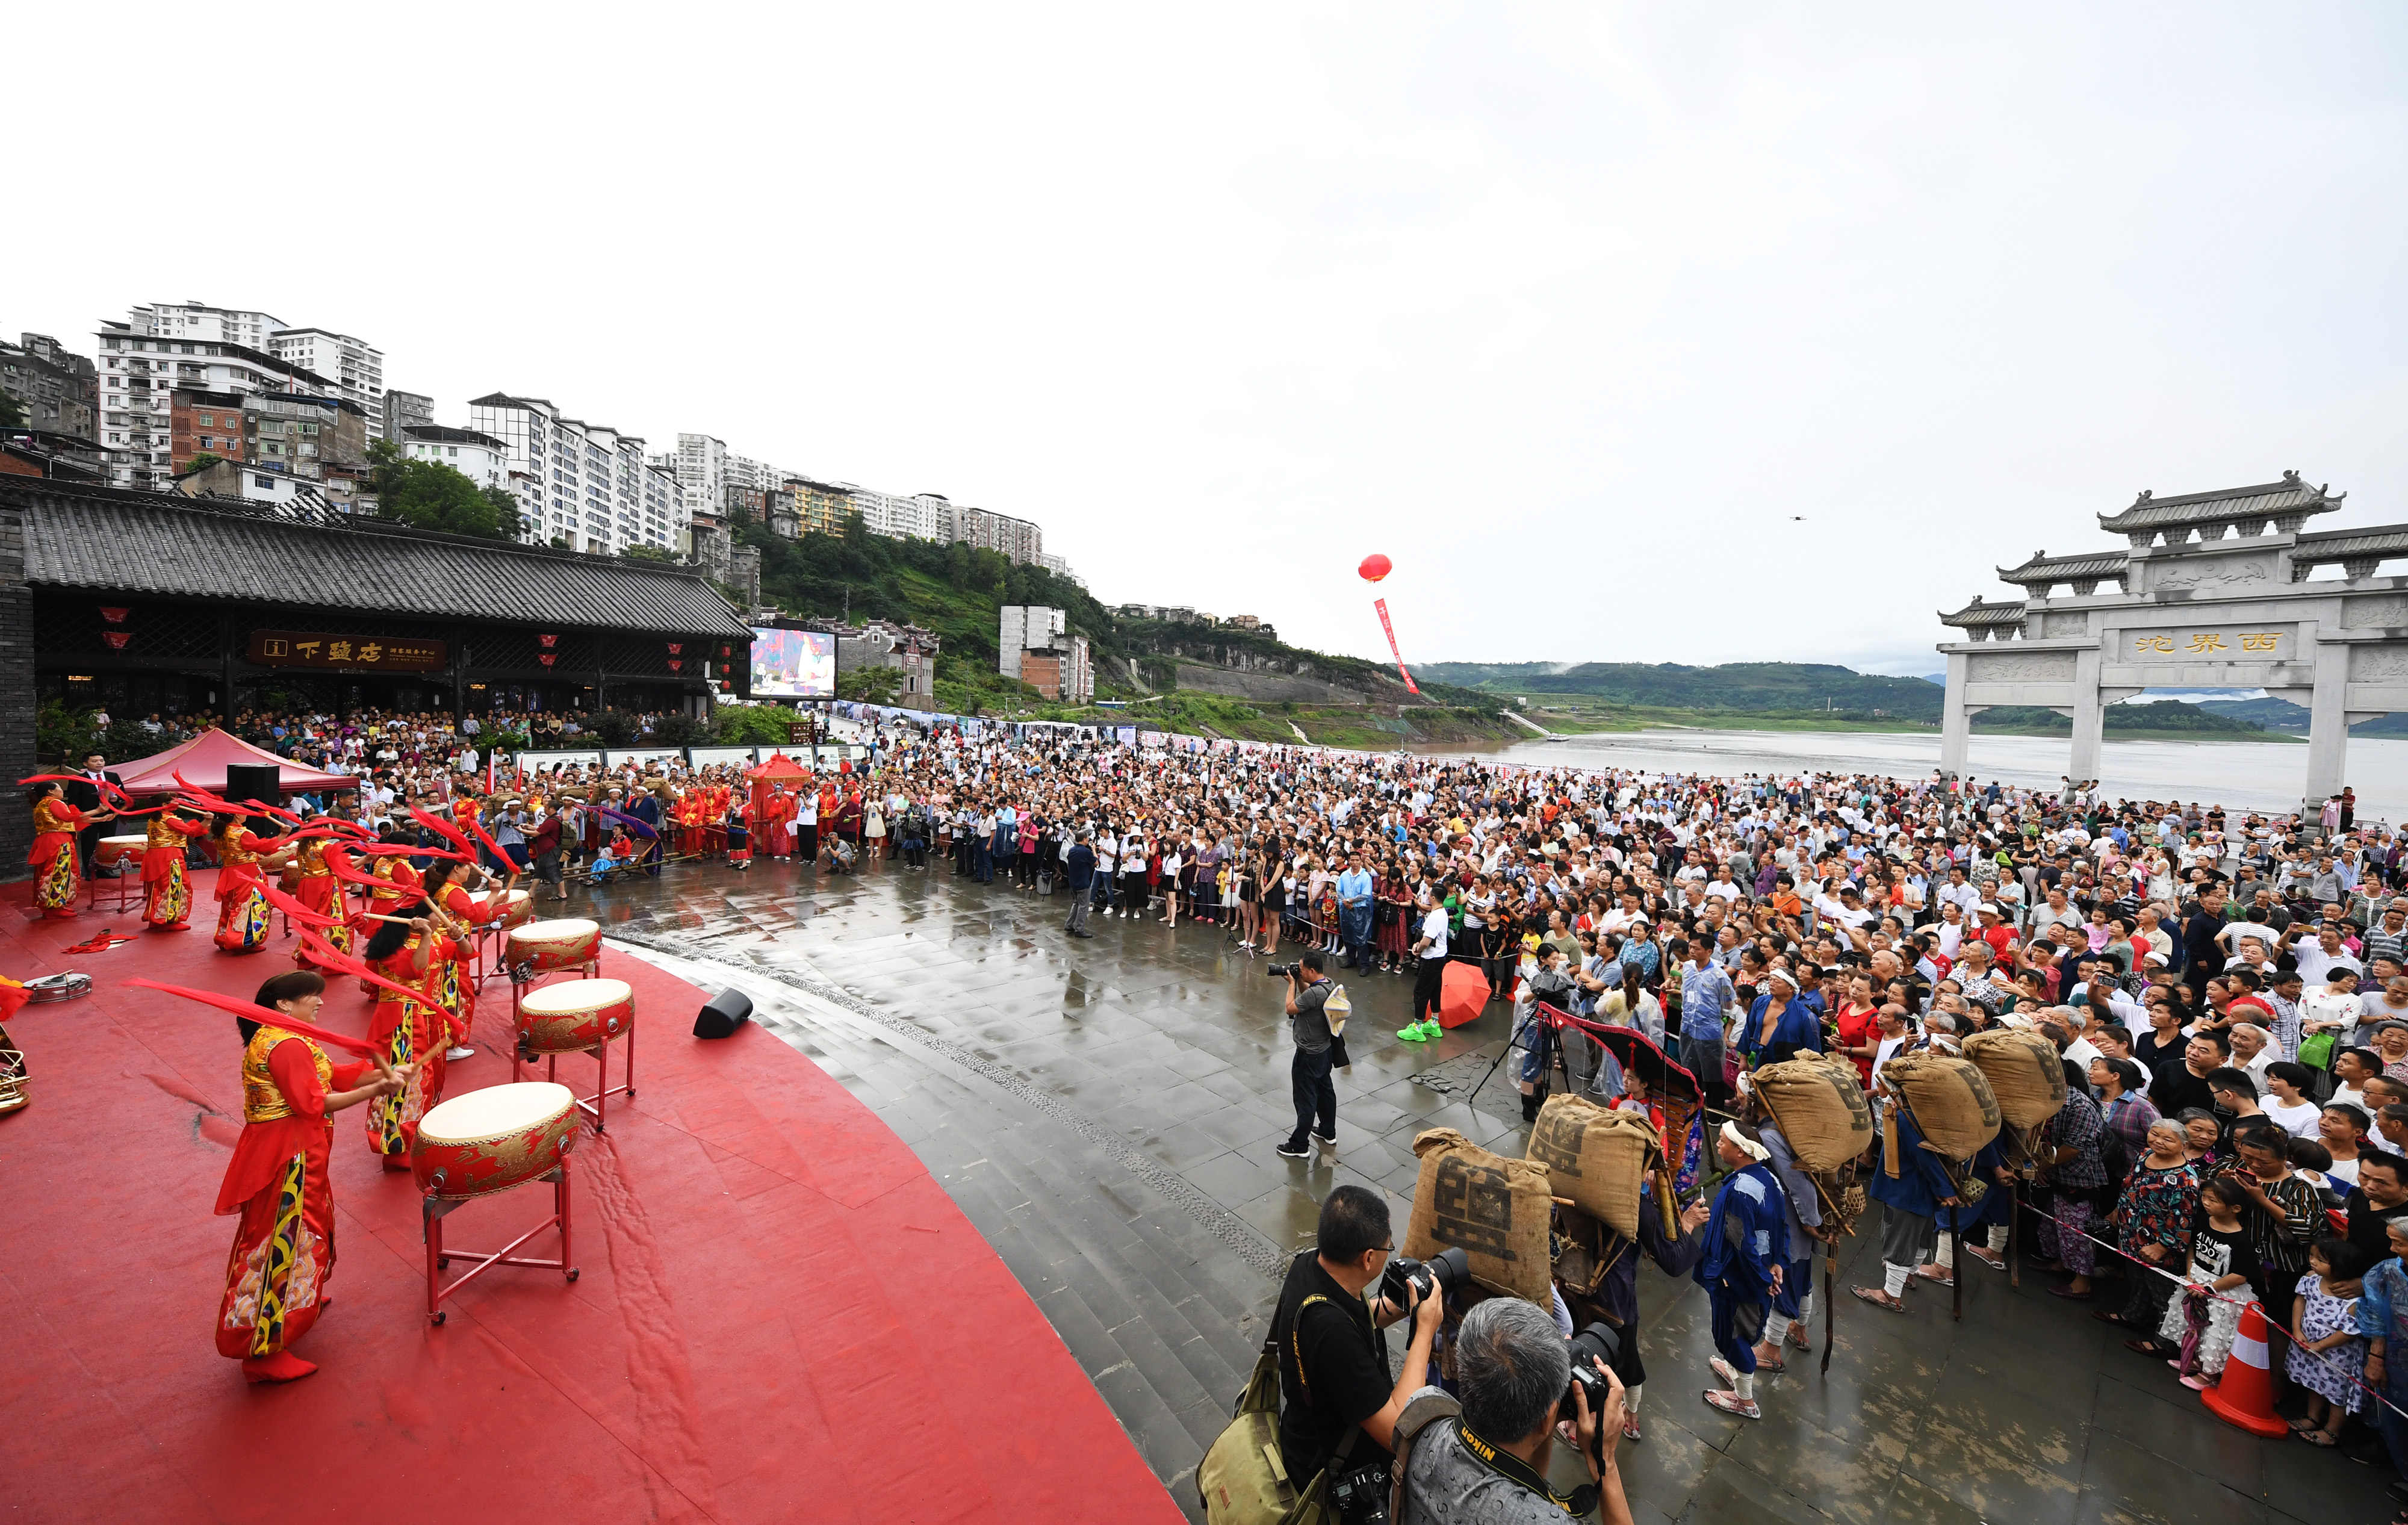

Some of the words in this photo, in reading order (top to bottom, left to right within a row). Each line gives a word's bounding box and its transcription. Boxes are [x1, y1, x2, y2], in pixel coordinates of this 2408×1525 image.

[2195, 1240, 2220, 1257] BOO
[2158, 1269, 2185, 1284] CAUTION
[1303, 1296, 1327, 1306] Nikon
[1461, 1427, 1496, 1462] Nikon
